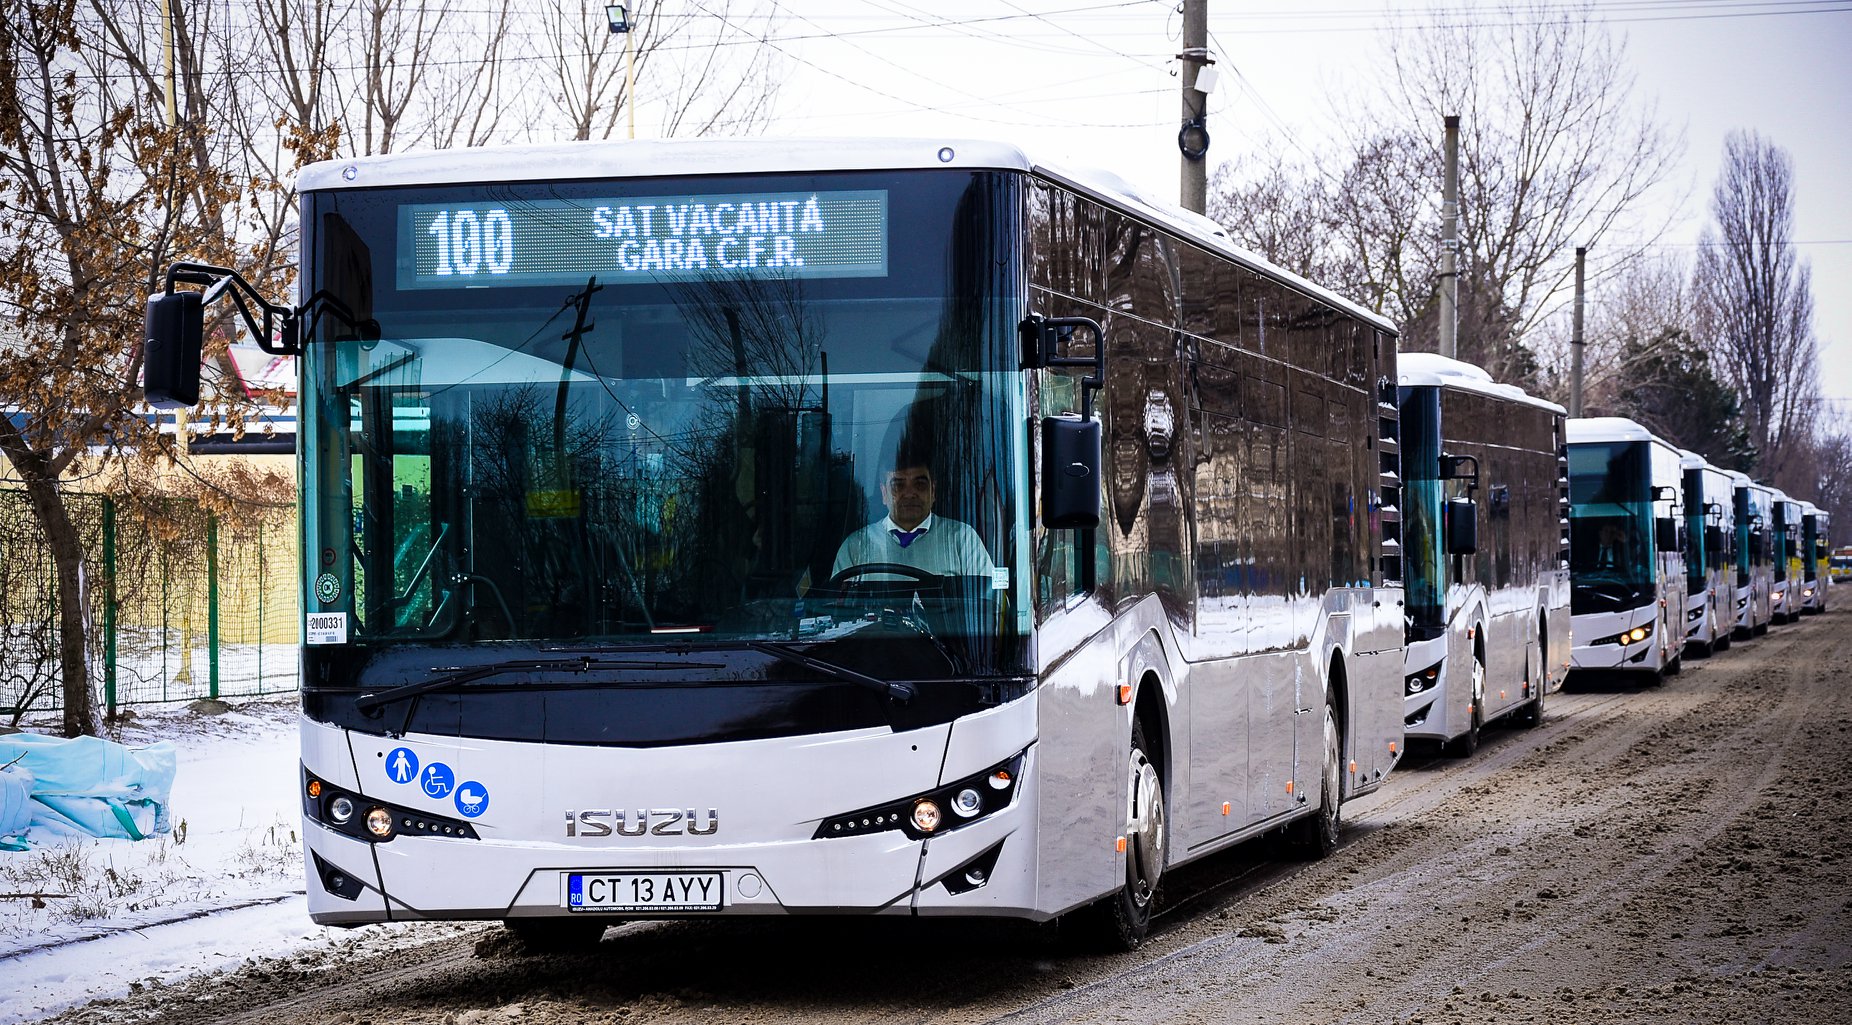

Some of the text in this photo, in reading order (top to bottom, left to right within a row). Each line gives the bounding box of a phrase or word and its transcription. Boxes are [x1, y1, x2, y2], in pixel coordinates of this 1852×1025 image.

[592, 200, 825, 238] SAT VACANTA
[428, 209, 514, 276] 100
[617, 236, 804, 271] GARA C.F.R.
[565, 807, 719, 838] ISUZU
[570, 876, 714, 904] RO CT 13 AYY
